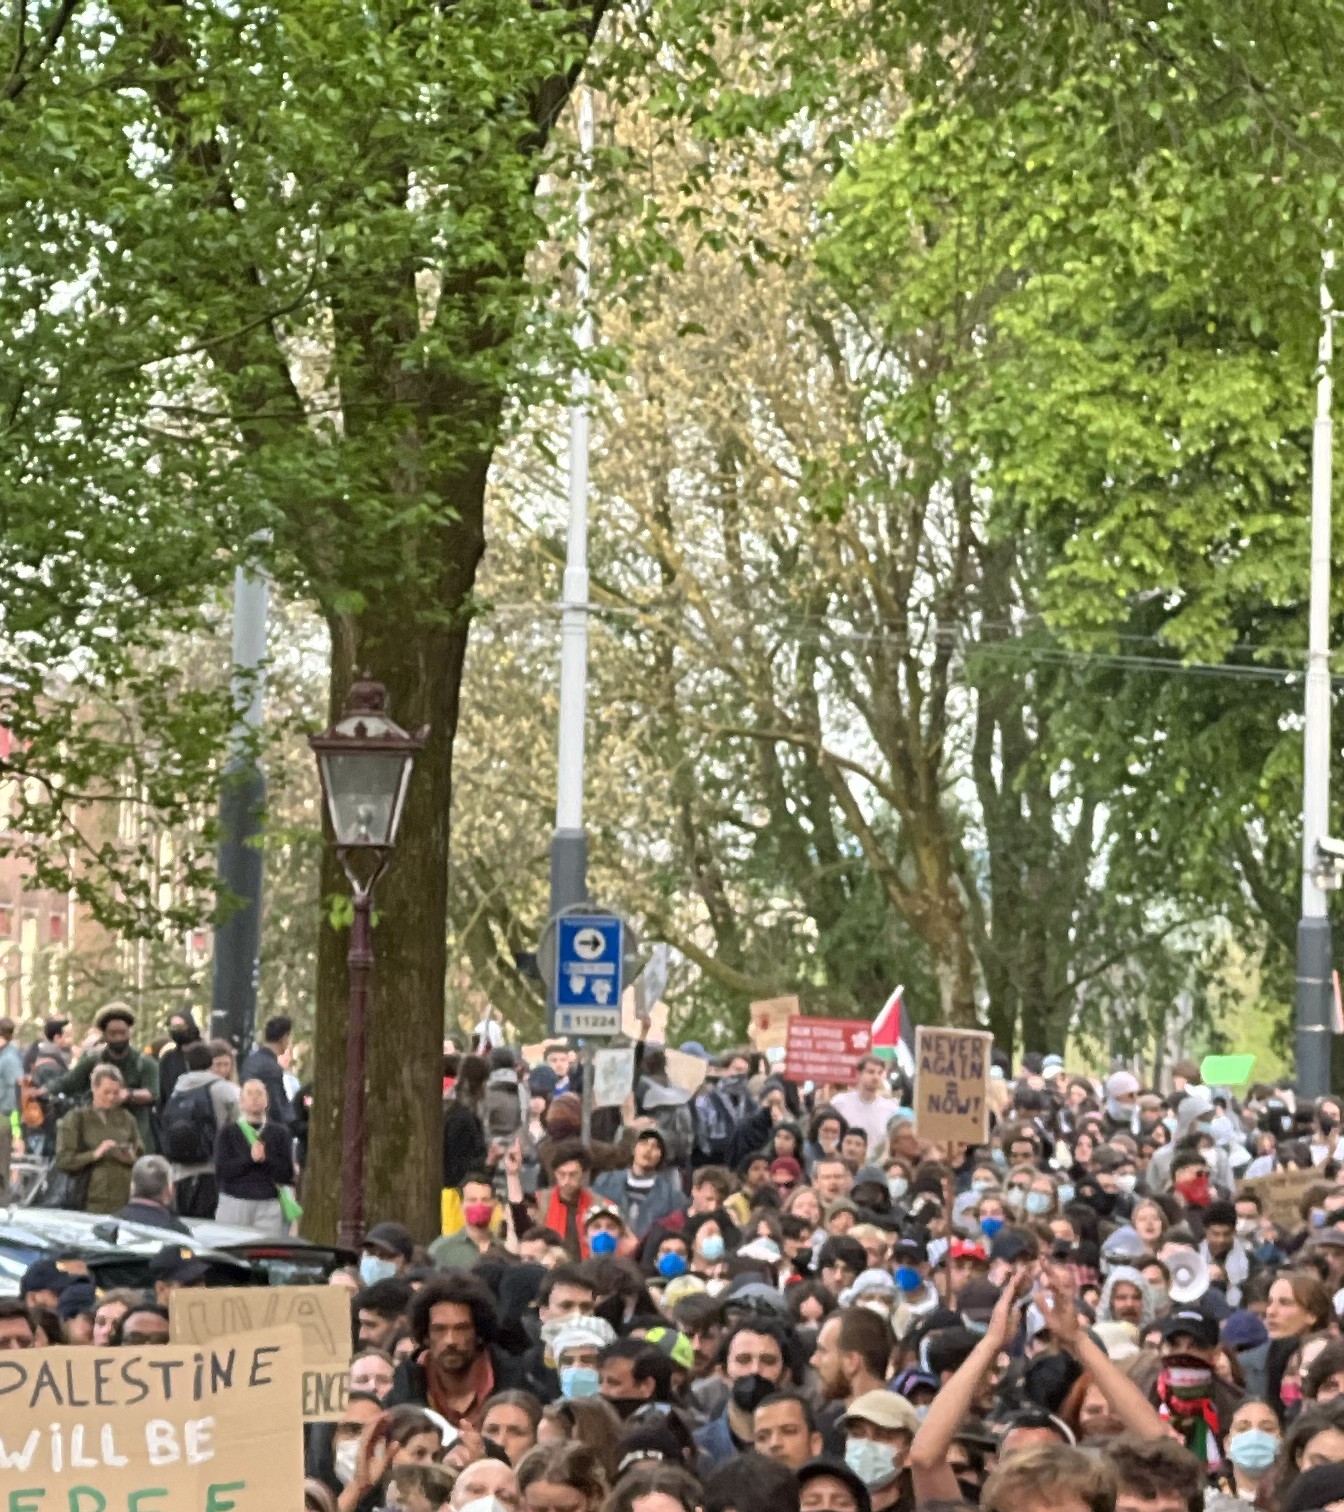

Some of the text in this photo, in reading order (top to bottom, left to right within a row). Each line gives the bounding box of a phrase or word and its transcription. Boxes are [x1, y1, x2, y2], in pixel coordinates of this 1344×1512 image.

[920, 1035, 983, 1057] NEVER
[922, 1056, 983, 1080] AGAIN
[928, 1094, 981, 1124] NOW!
[145, 1415, 218, 1467] BE
